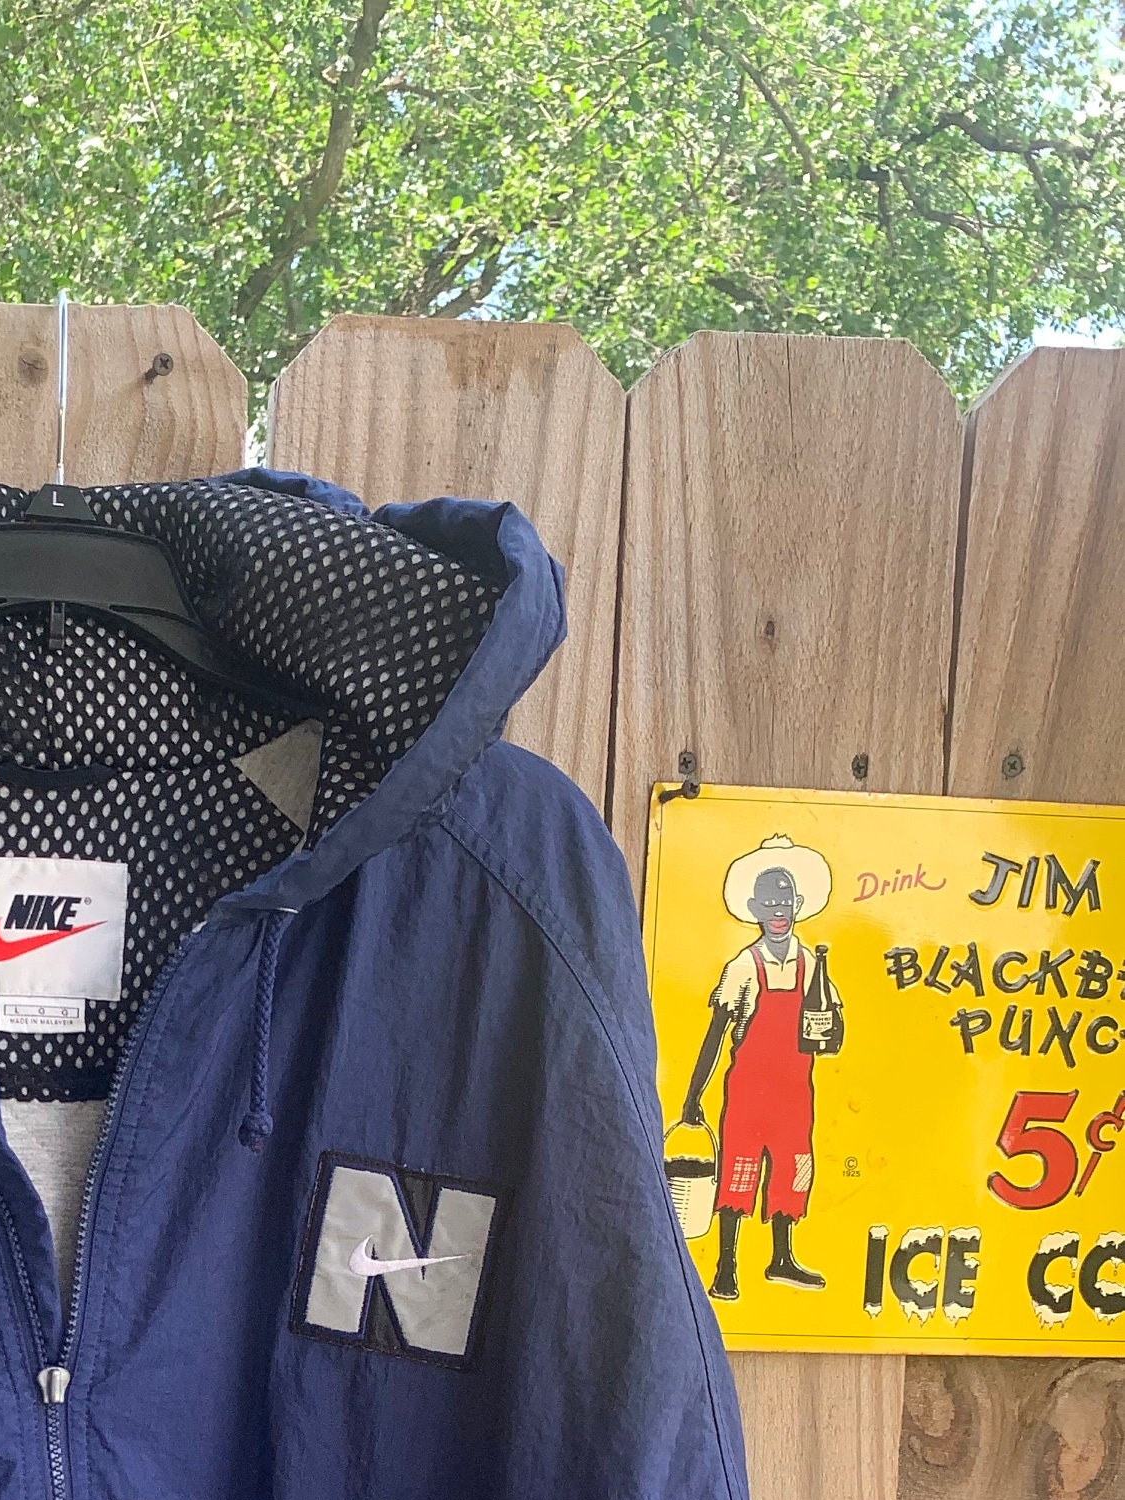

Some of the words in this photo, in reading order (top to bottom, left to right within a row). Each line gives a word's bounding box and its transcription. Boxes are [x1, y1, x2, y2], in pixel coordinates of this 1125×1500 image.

[52, 490, 65, 507] L
[3, 894, 82, 932] NIKE
[853, 863, 947, 903] Drink
[968, 851, 1102, 917] JIM
[883, 941, 1125, 1001] BLACKB
[9, 1017, 28, 1025] MADE
[949, 1005, 1125, 1068] PUNC
[841, 1170, 861, 1178] 1925
[304, 1166, 497, 1356] N
[863, 1225, 982, 1328] ICE
